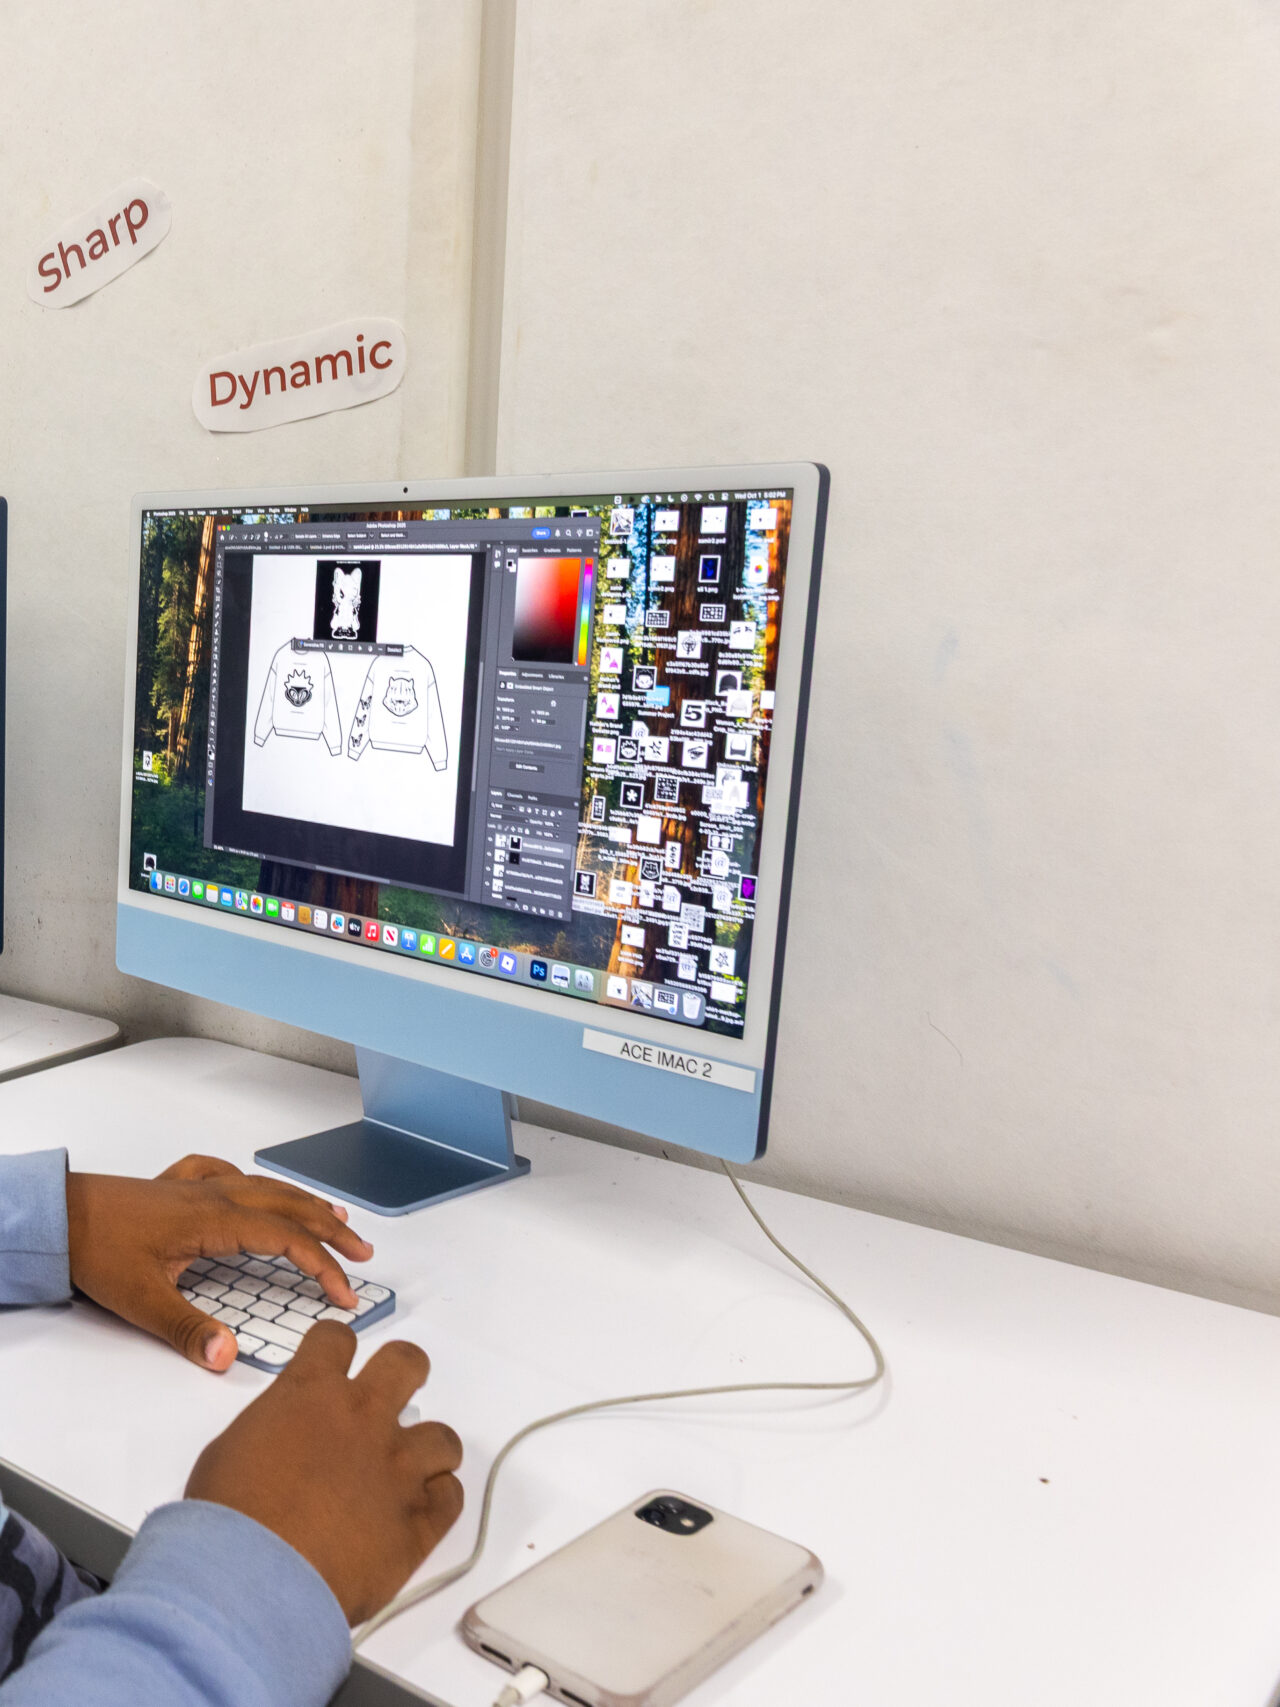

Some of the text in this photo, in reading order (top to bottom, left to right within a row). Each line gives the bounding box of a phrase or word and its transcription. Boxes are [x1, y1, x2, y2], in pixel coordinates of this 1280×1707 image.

[37, 197, 150, 293] Sharp
[209, 333, 394, 410] Dynamic
[684, 704, 702, 722] 5
[533, 964, 545, 977] Ps
[620, 1042, 712, 1078] ACE IMAC 2
